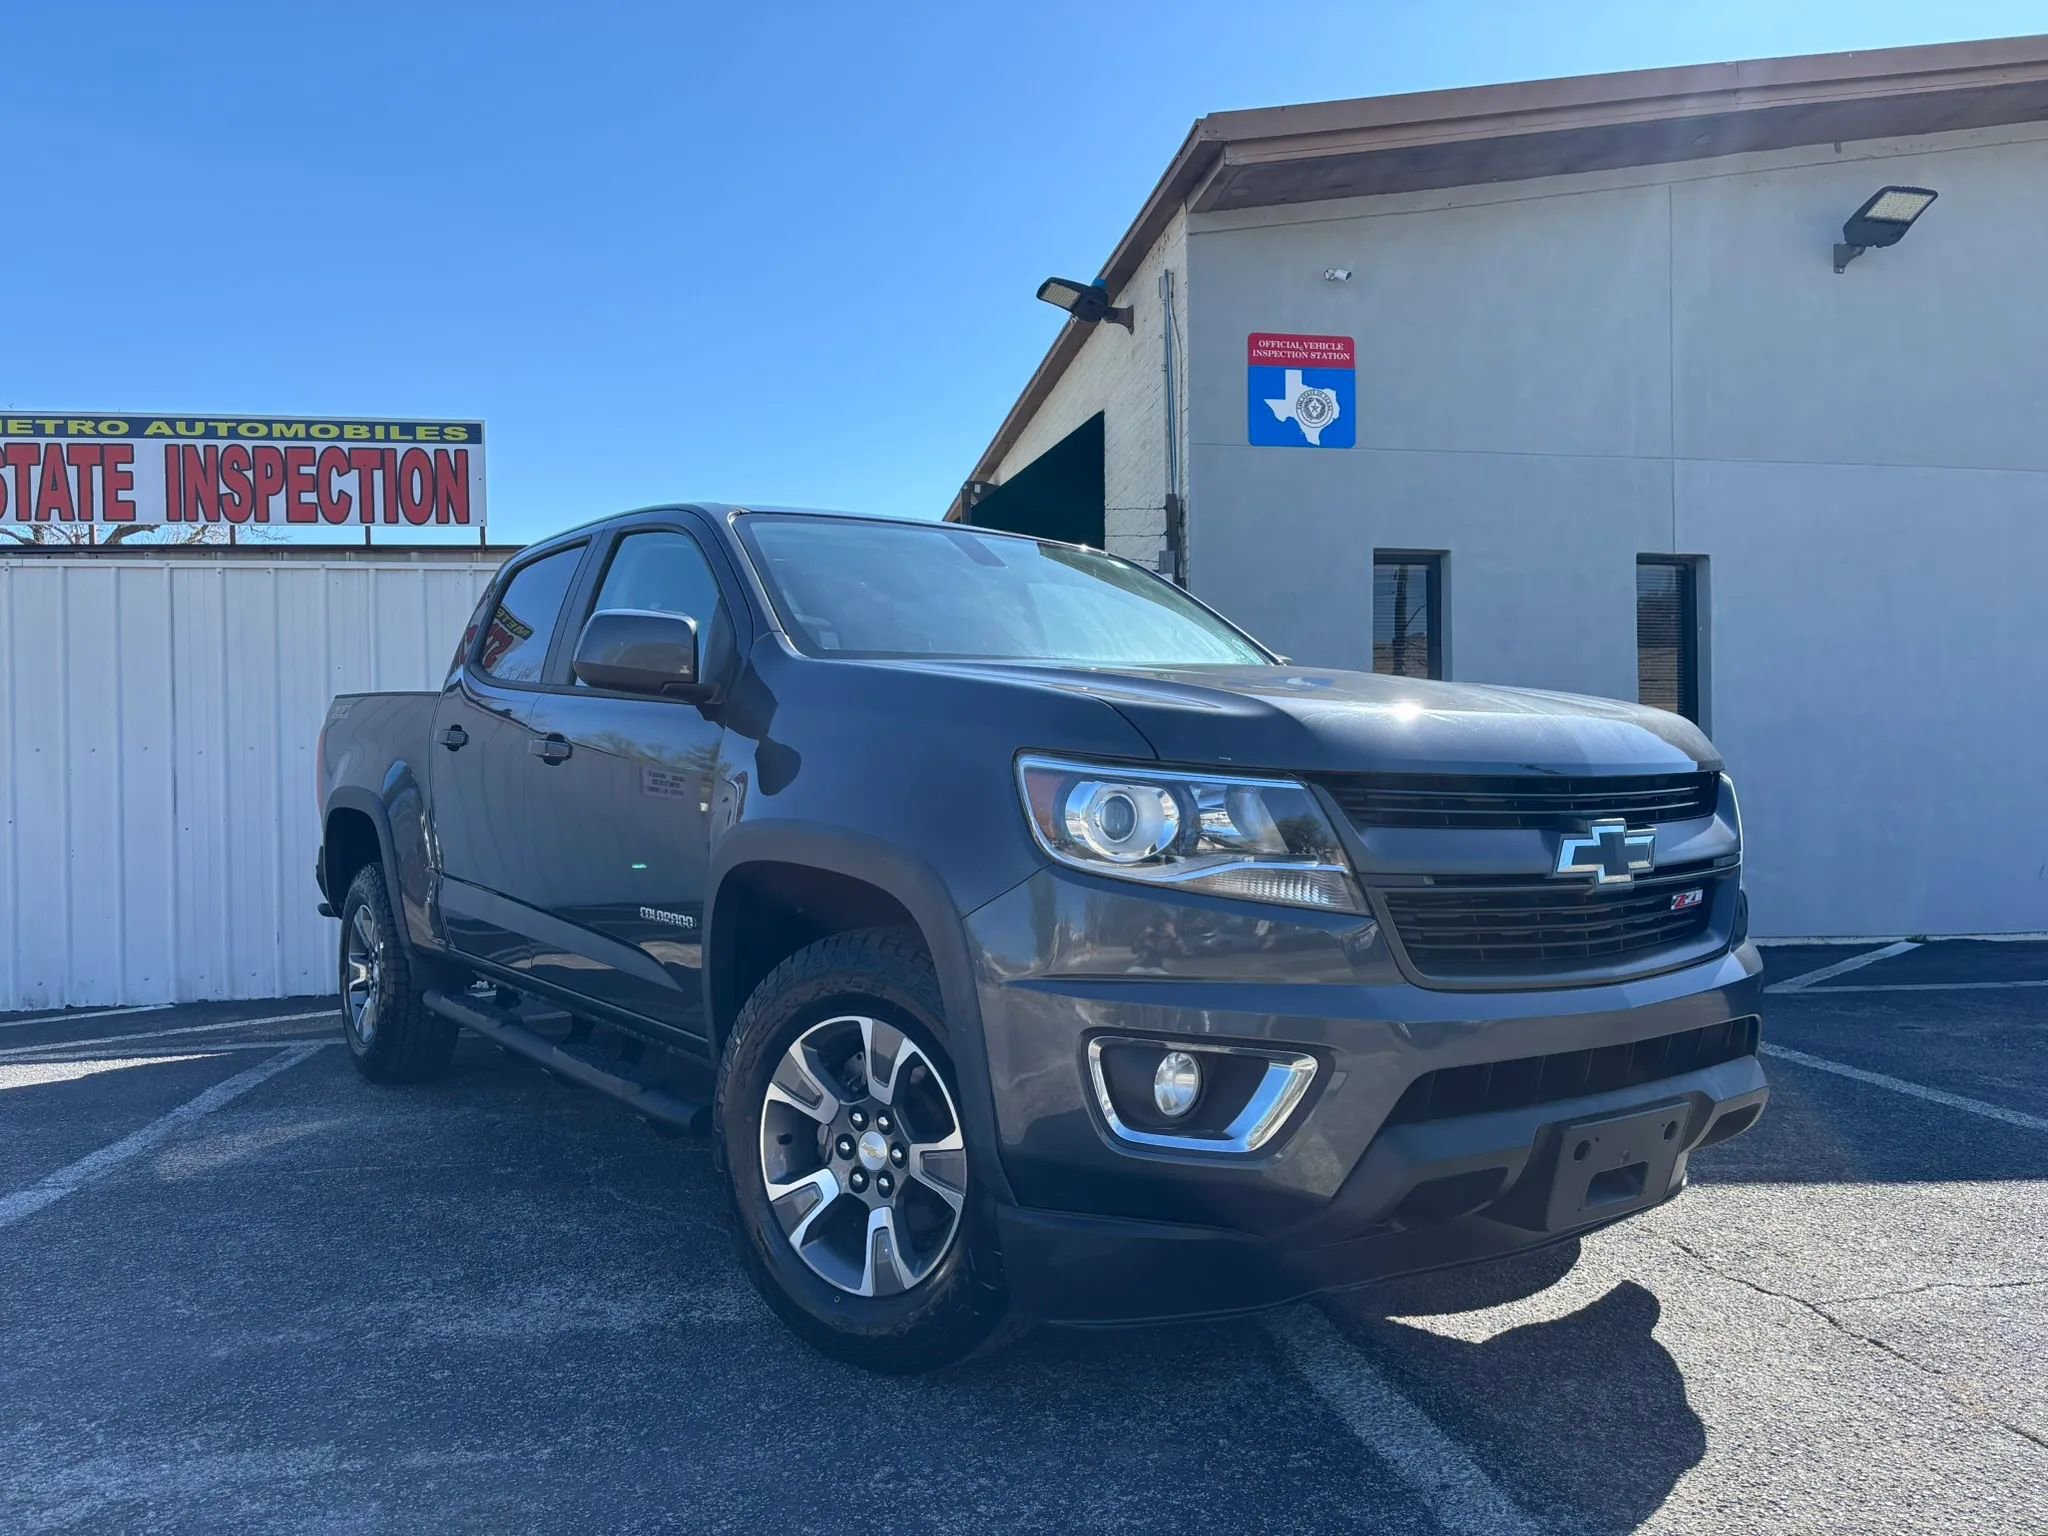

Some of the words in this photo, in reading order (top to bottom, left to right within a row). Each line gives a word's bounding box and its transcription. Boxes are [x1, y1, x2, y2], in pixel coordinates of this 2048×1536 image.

[1252, 349, 1309, 359] INSPECTION
[1310, 351, 1350, 360] STATION
[1258, 339, 1301, 350] OFFICIAL
[1303, 341, 1344, 351] VEHICLE
[0, 419, 130, 436] ETRO
[144, 420, 470, 441] AUTOMOBILES
[164, 444, 471, 525] INSPECTION
[639, 906, 697, 929] COLORADO
